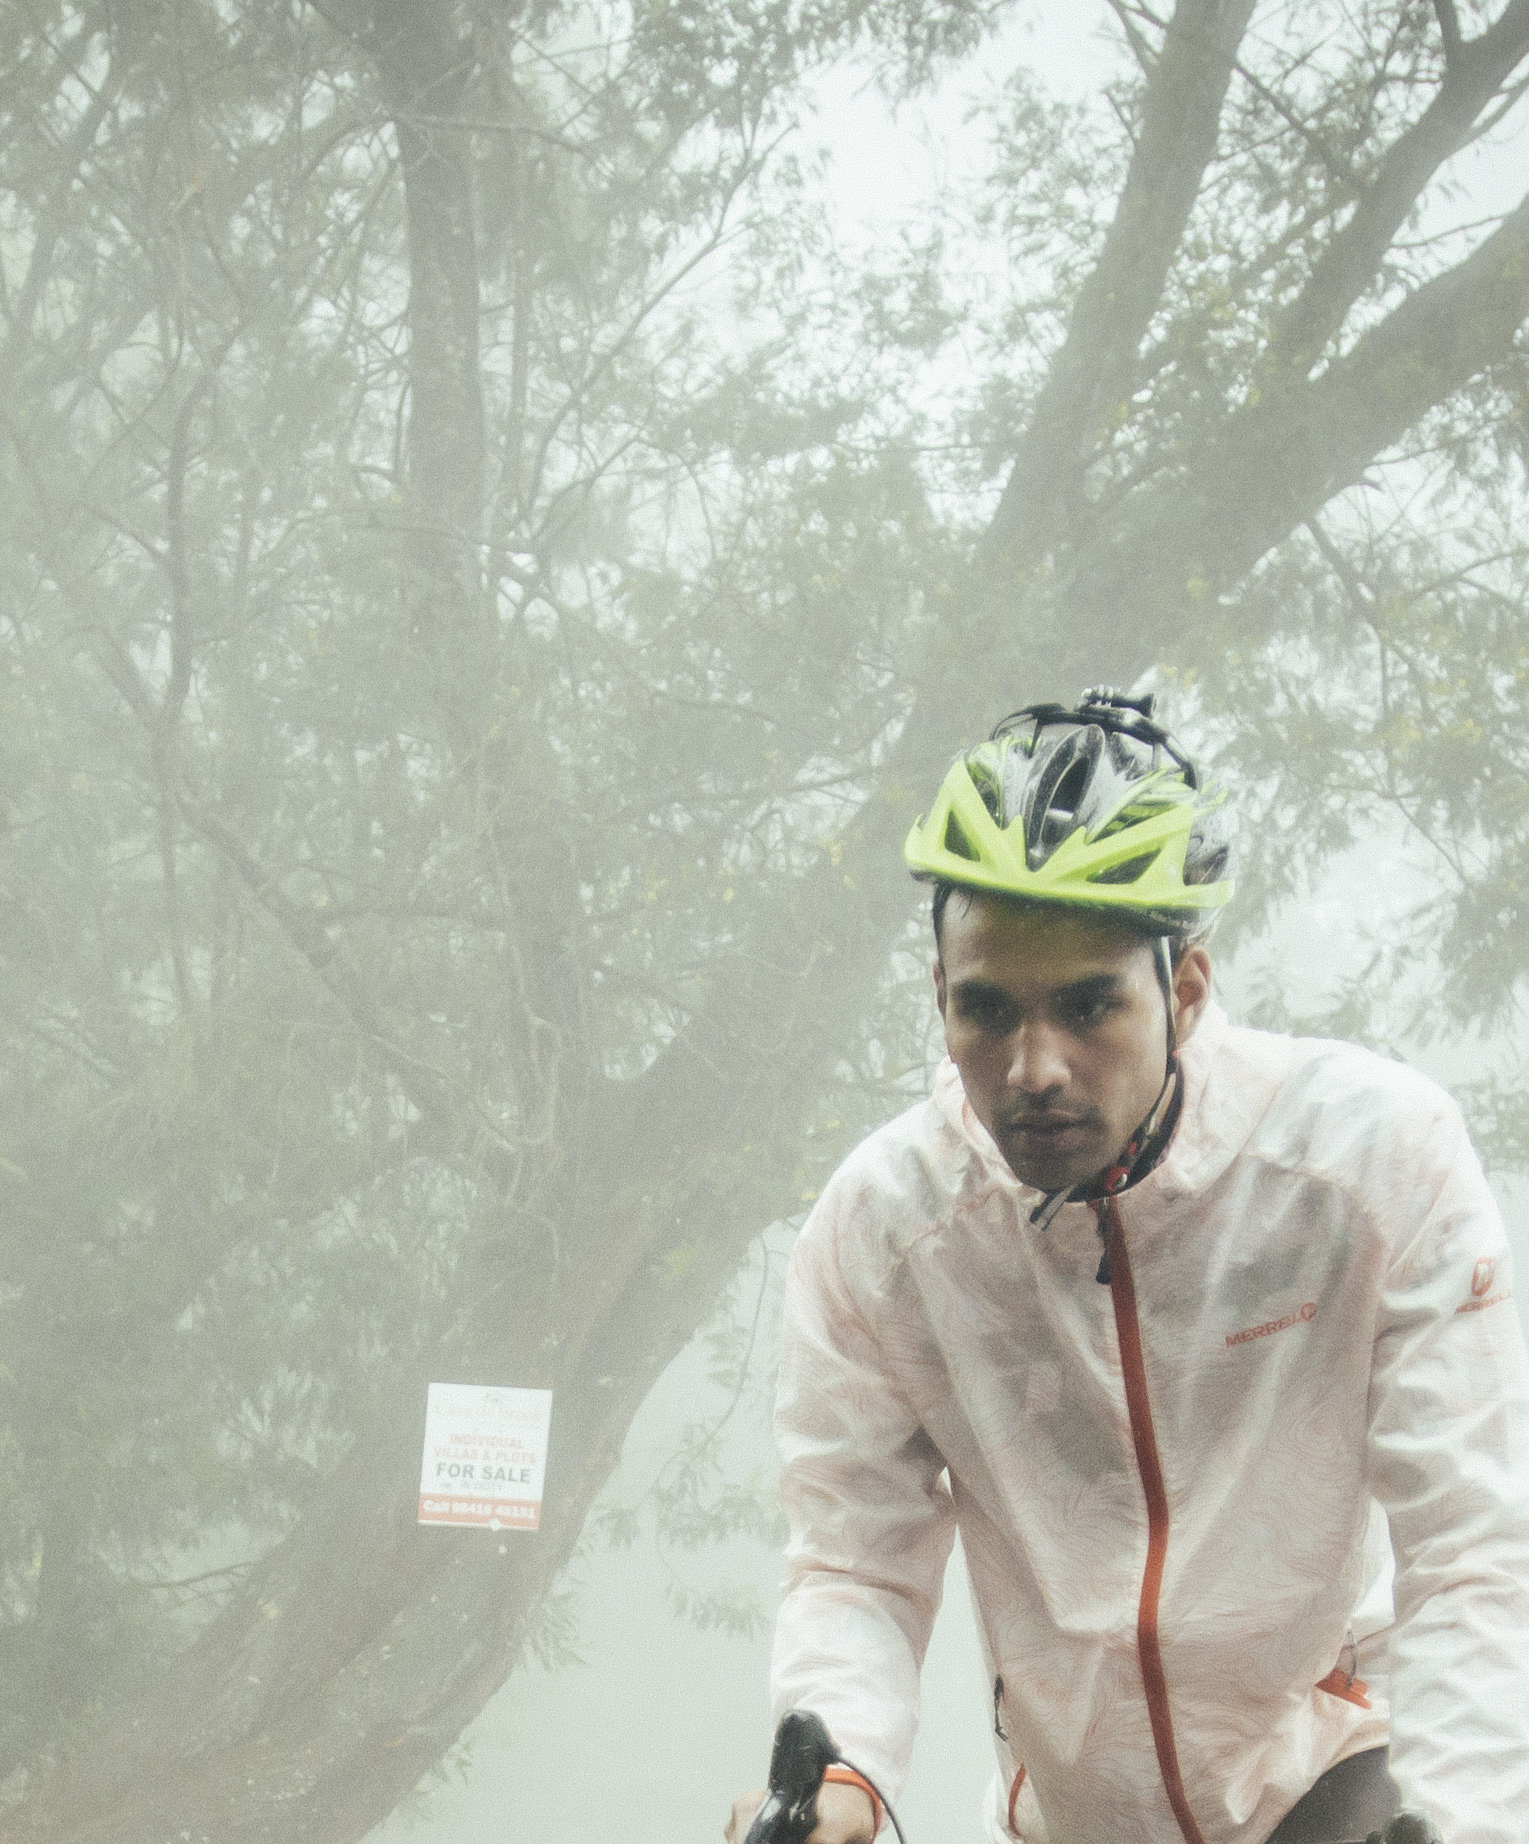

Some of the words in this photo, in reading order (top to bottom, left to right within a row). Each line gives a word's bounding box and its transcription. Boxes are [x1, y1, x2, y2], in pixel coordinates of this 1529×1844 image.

[437, 1463, 474, 1479] FOR
[483, 1466, 531, 1483] SALE
[423, 1500, 449, 1513] Call
